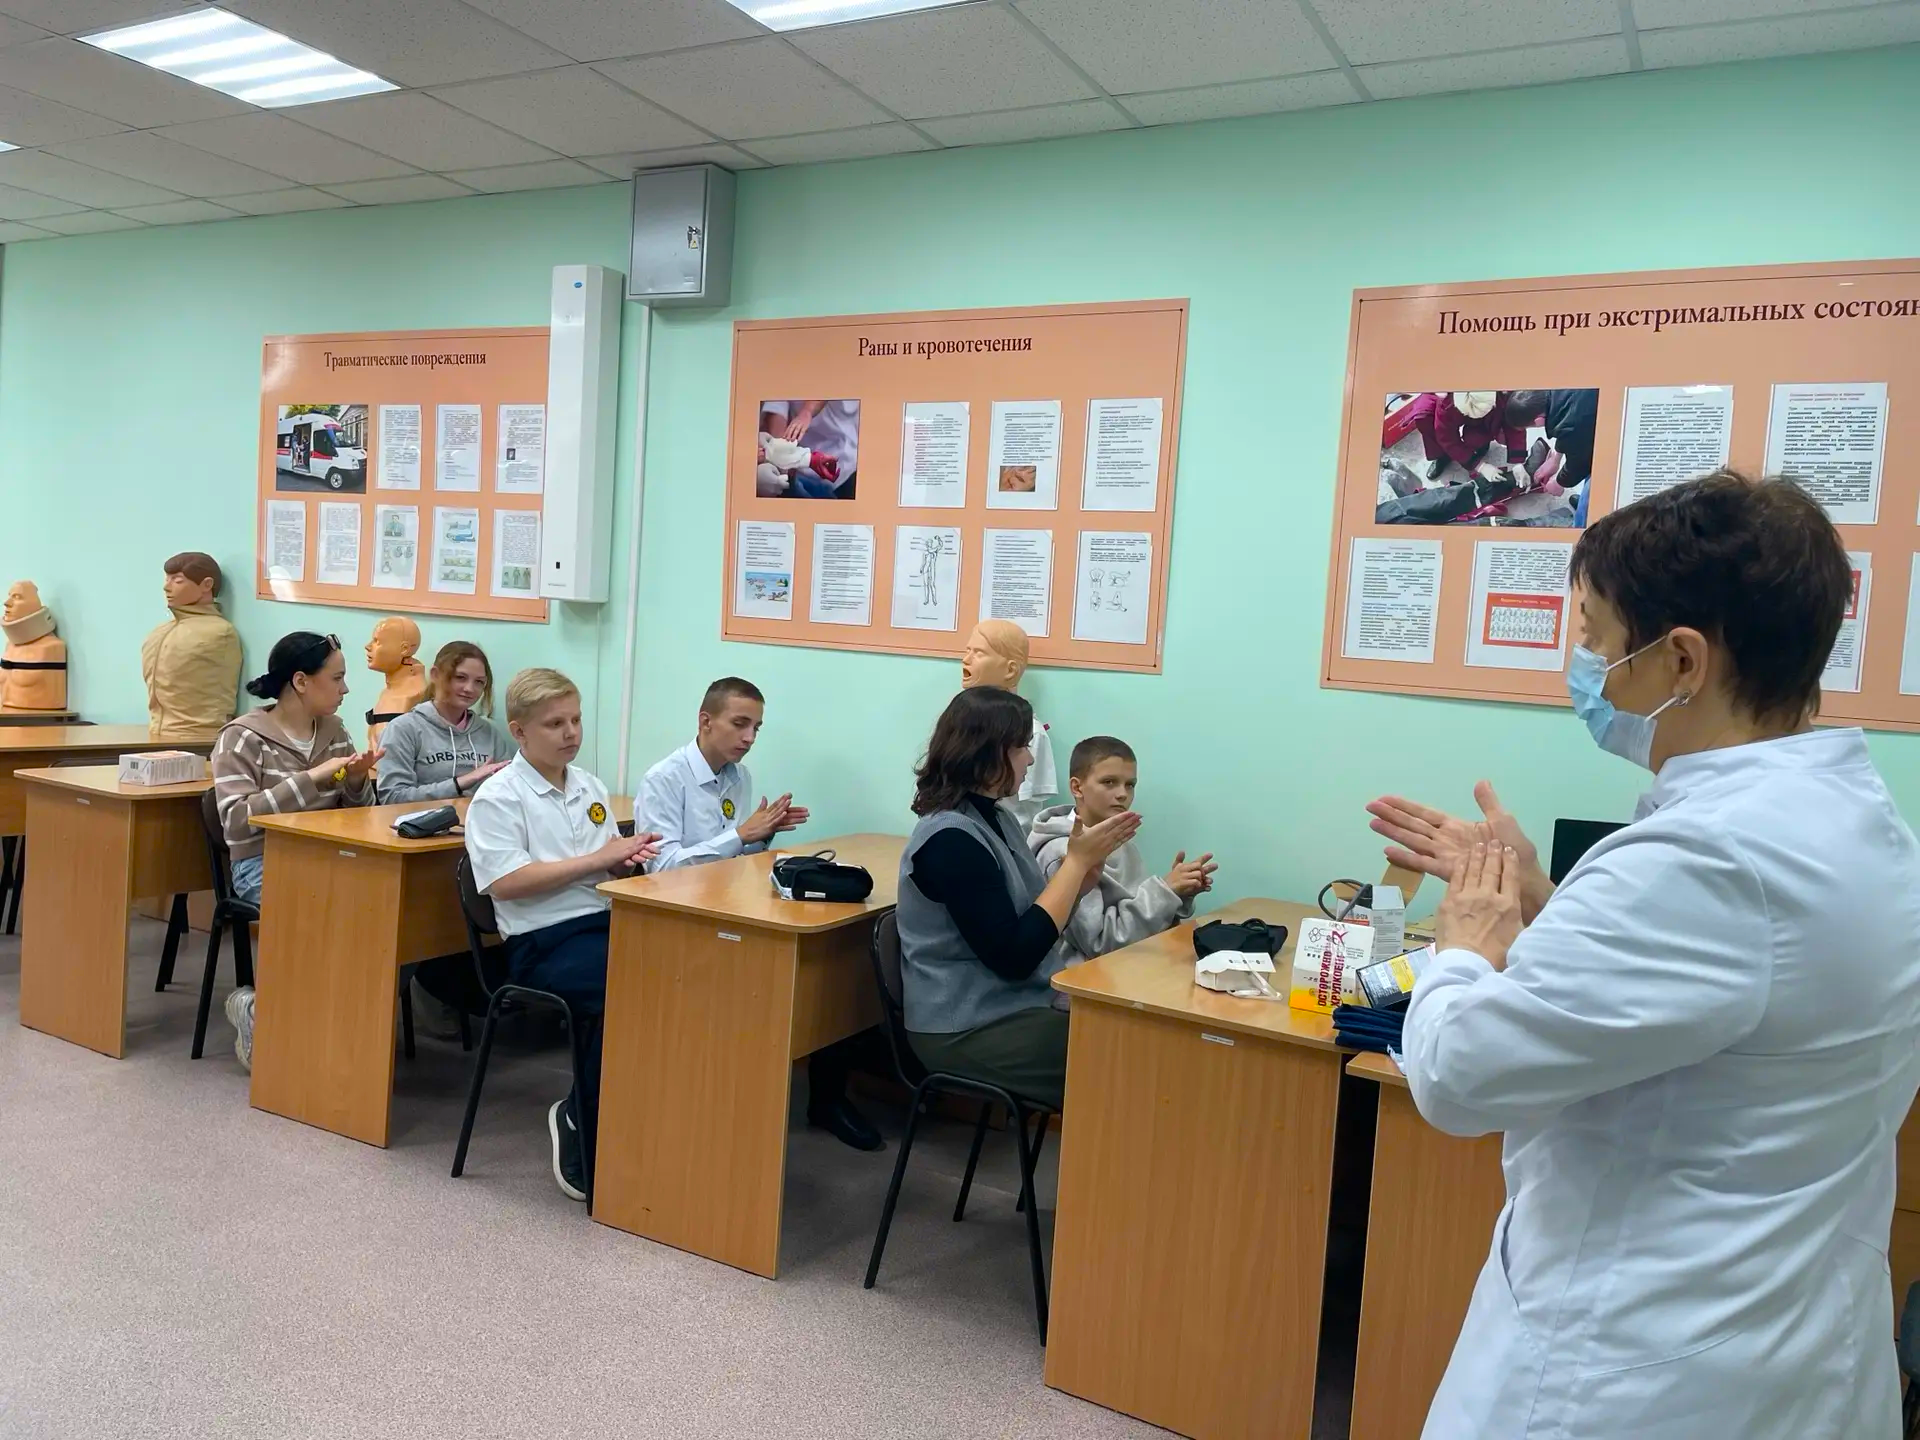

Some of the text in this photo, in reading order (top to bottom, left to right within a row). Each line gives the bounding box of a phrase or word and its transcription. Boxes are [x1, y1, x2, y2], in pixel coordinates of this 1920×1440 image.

[1437, 310, 1537, 335] Помощь
[1543, 312, 1591, 336] при
[1597, 302, 1806, 333] экстримальных
[323, 351, 487, 372] Травматические повреждения
[858, 336, 1033, 360] Раны и кровотечения
[1317, 950, 1333, 1007] ОСТОРОЖНО
